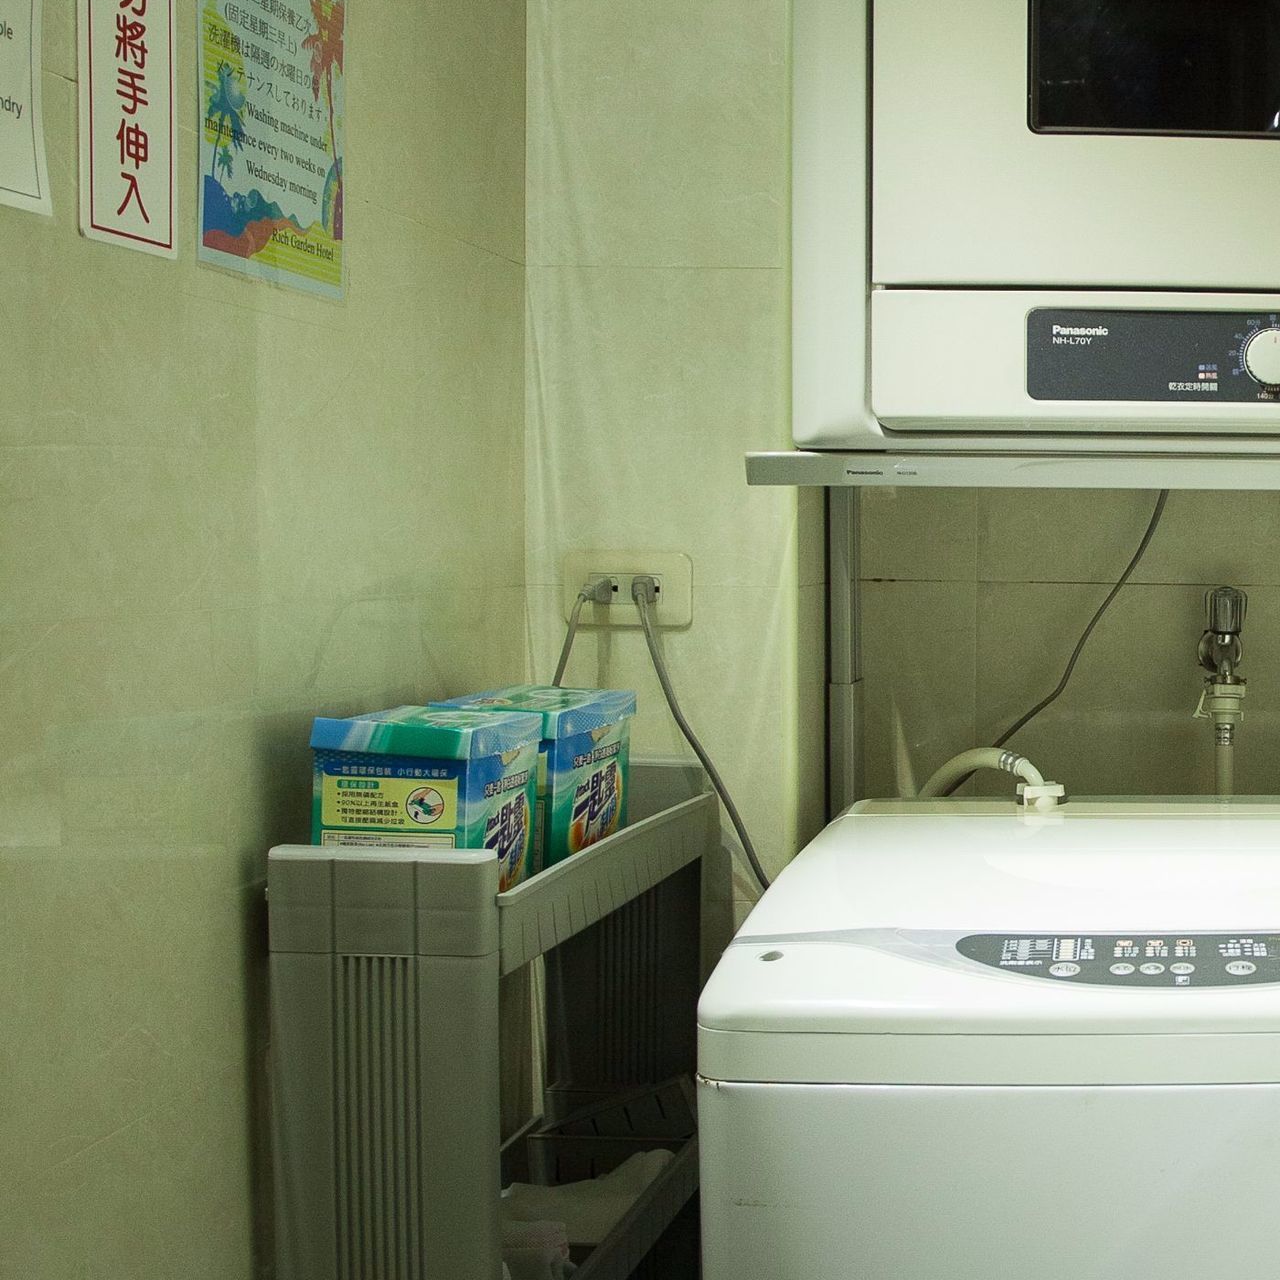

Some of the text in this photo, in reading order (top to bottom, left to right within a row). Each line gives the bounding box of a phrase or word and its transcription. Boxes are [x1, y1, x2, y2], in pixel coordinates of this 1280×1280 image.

[204, 117, 326, 178] maintenance every two weeks on
[246, 102, 328, 153] Washing machine under
[246, 159, 318, 205] Wednesday morning
[272, 227, 334, 262] Rich Garden Hotel
[1052, 325, 1109, 336] Panasonic
[1052, 337, 1092, 345] NH-L70Y
